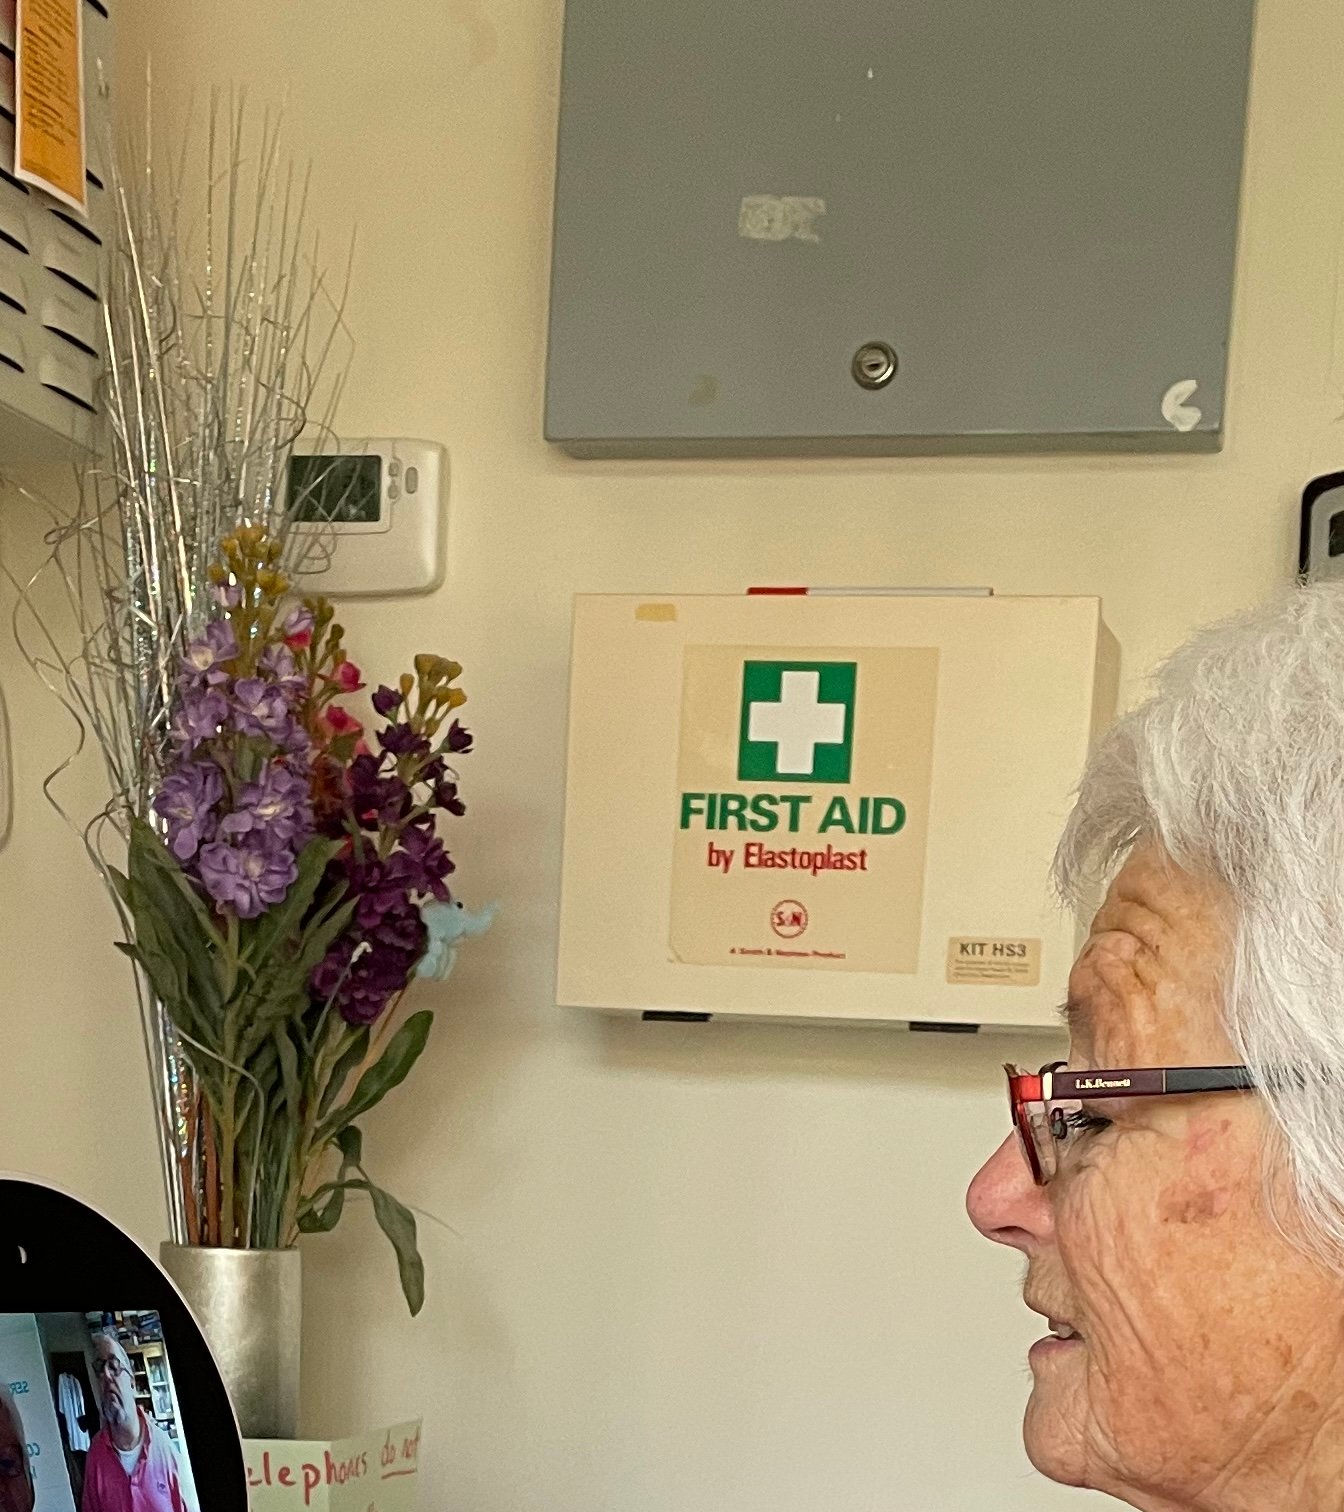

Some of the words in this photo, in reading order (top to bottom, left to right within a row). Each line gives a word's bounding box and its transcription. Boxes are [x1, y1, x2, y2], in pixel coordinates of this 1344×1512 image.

[680, 792, 812, 832] FIRST
[818, 796, 906, 835] AID
[707, 842, 735, 874] by
[744, 842, 868, 877] Elastoplast
[959, 942, 988, 956] KIT
[992, 943, 1026, 957] HS3
[381, 1429, 395, 1467] do
[403, 1424, 420, 1458] not
